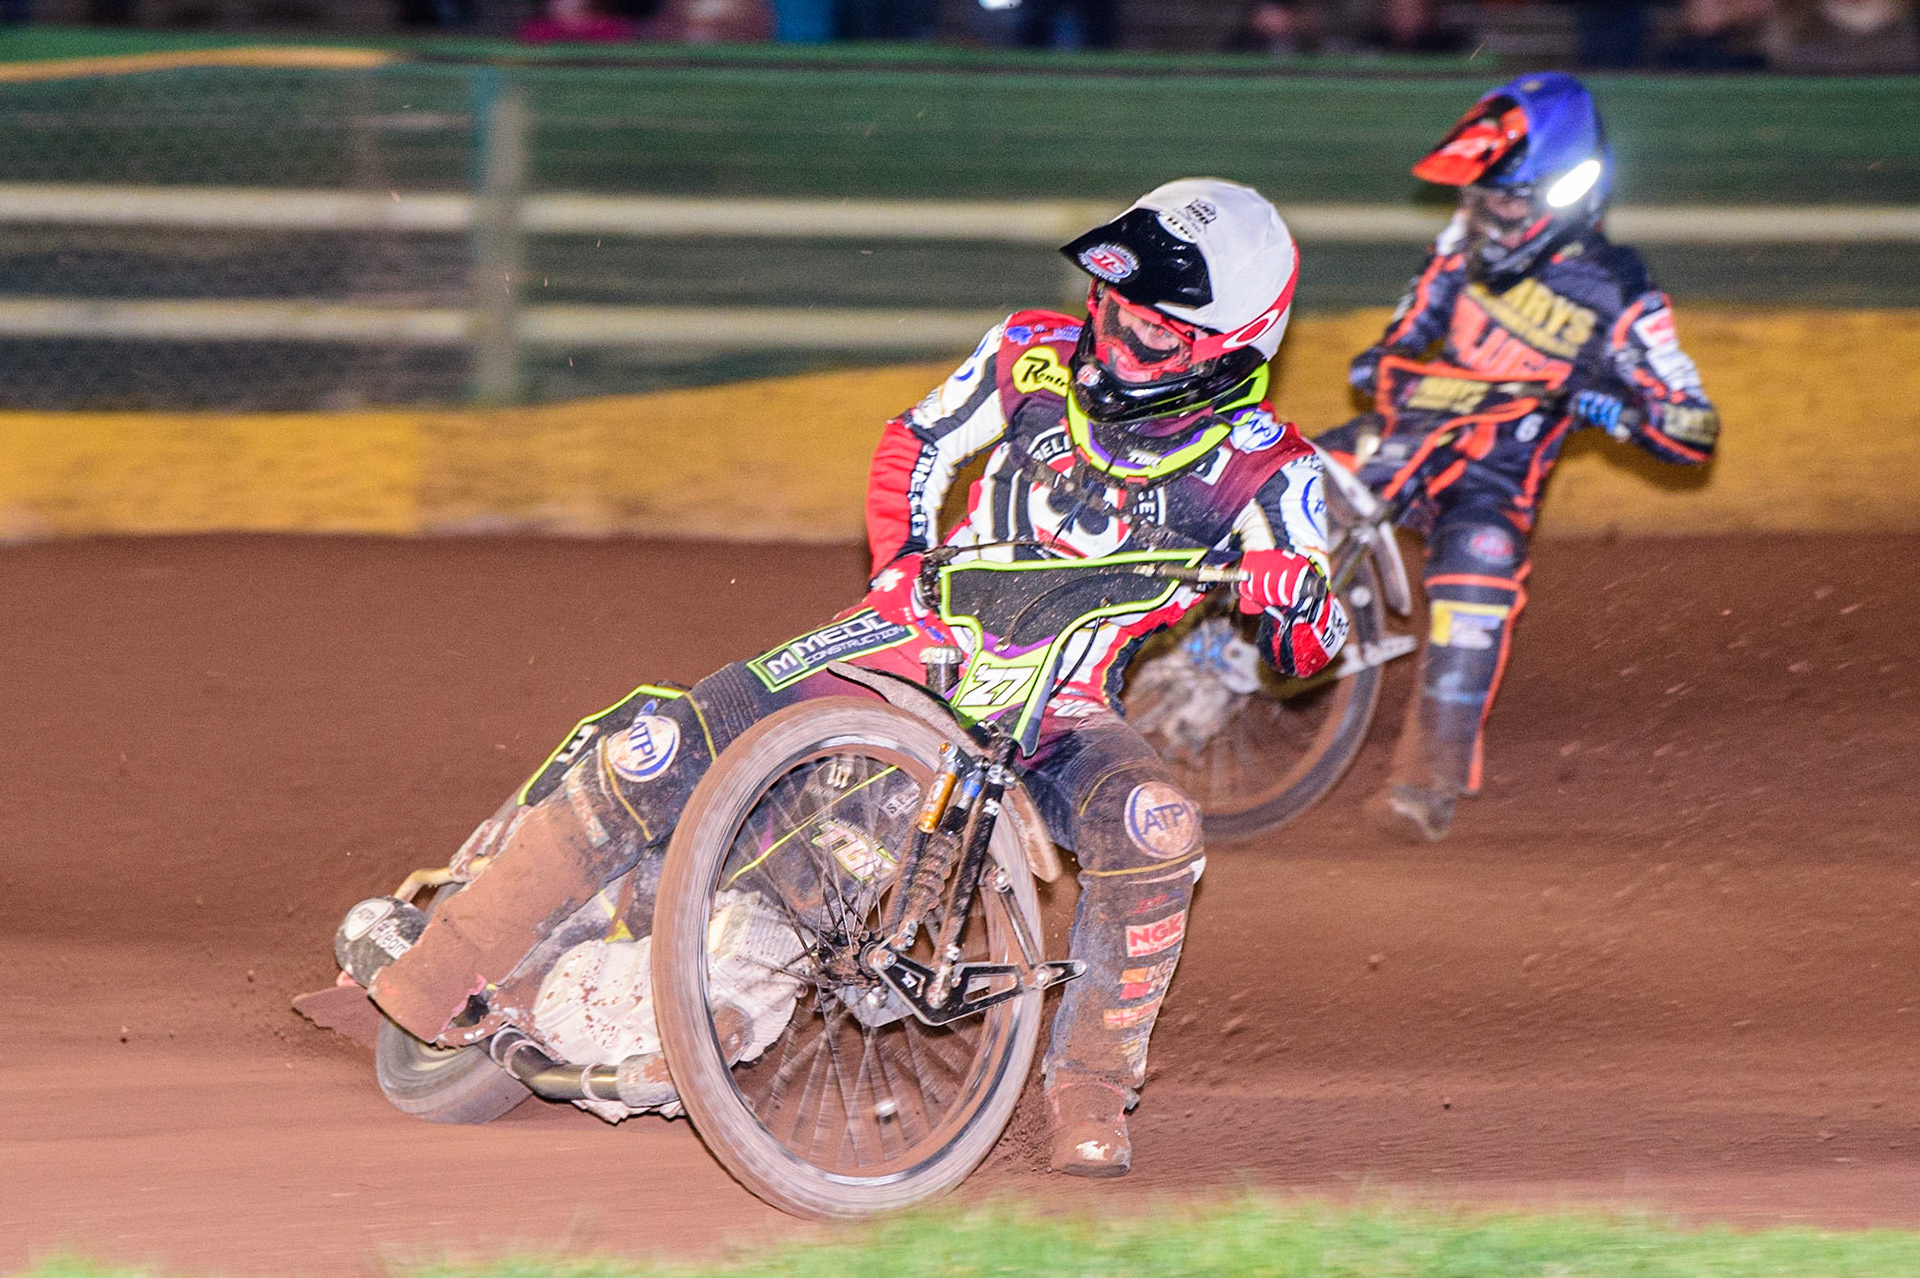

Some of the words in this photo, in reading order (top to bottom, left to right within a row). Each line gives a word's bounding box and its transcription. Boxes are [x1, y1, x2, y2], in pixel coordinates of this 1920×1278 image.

[1089, 249, 1127, 275] STS
[804, 625, 906, 665] CONSTRUCTION
[766, 651, 799, 676] M
[628, 721, 658, 766] ATPI
[1129, 914, 1184, 948] NGK
